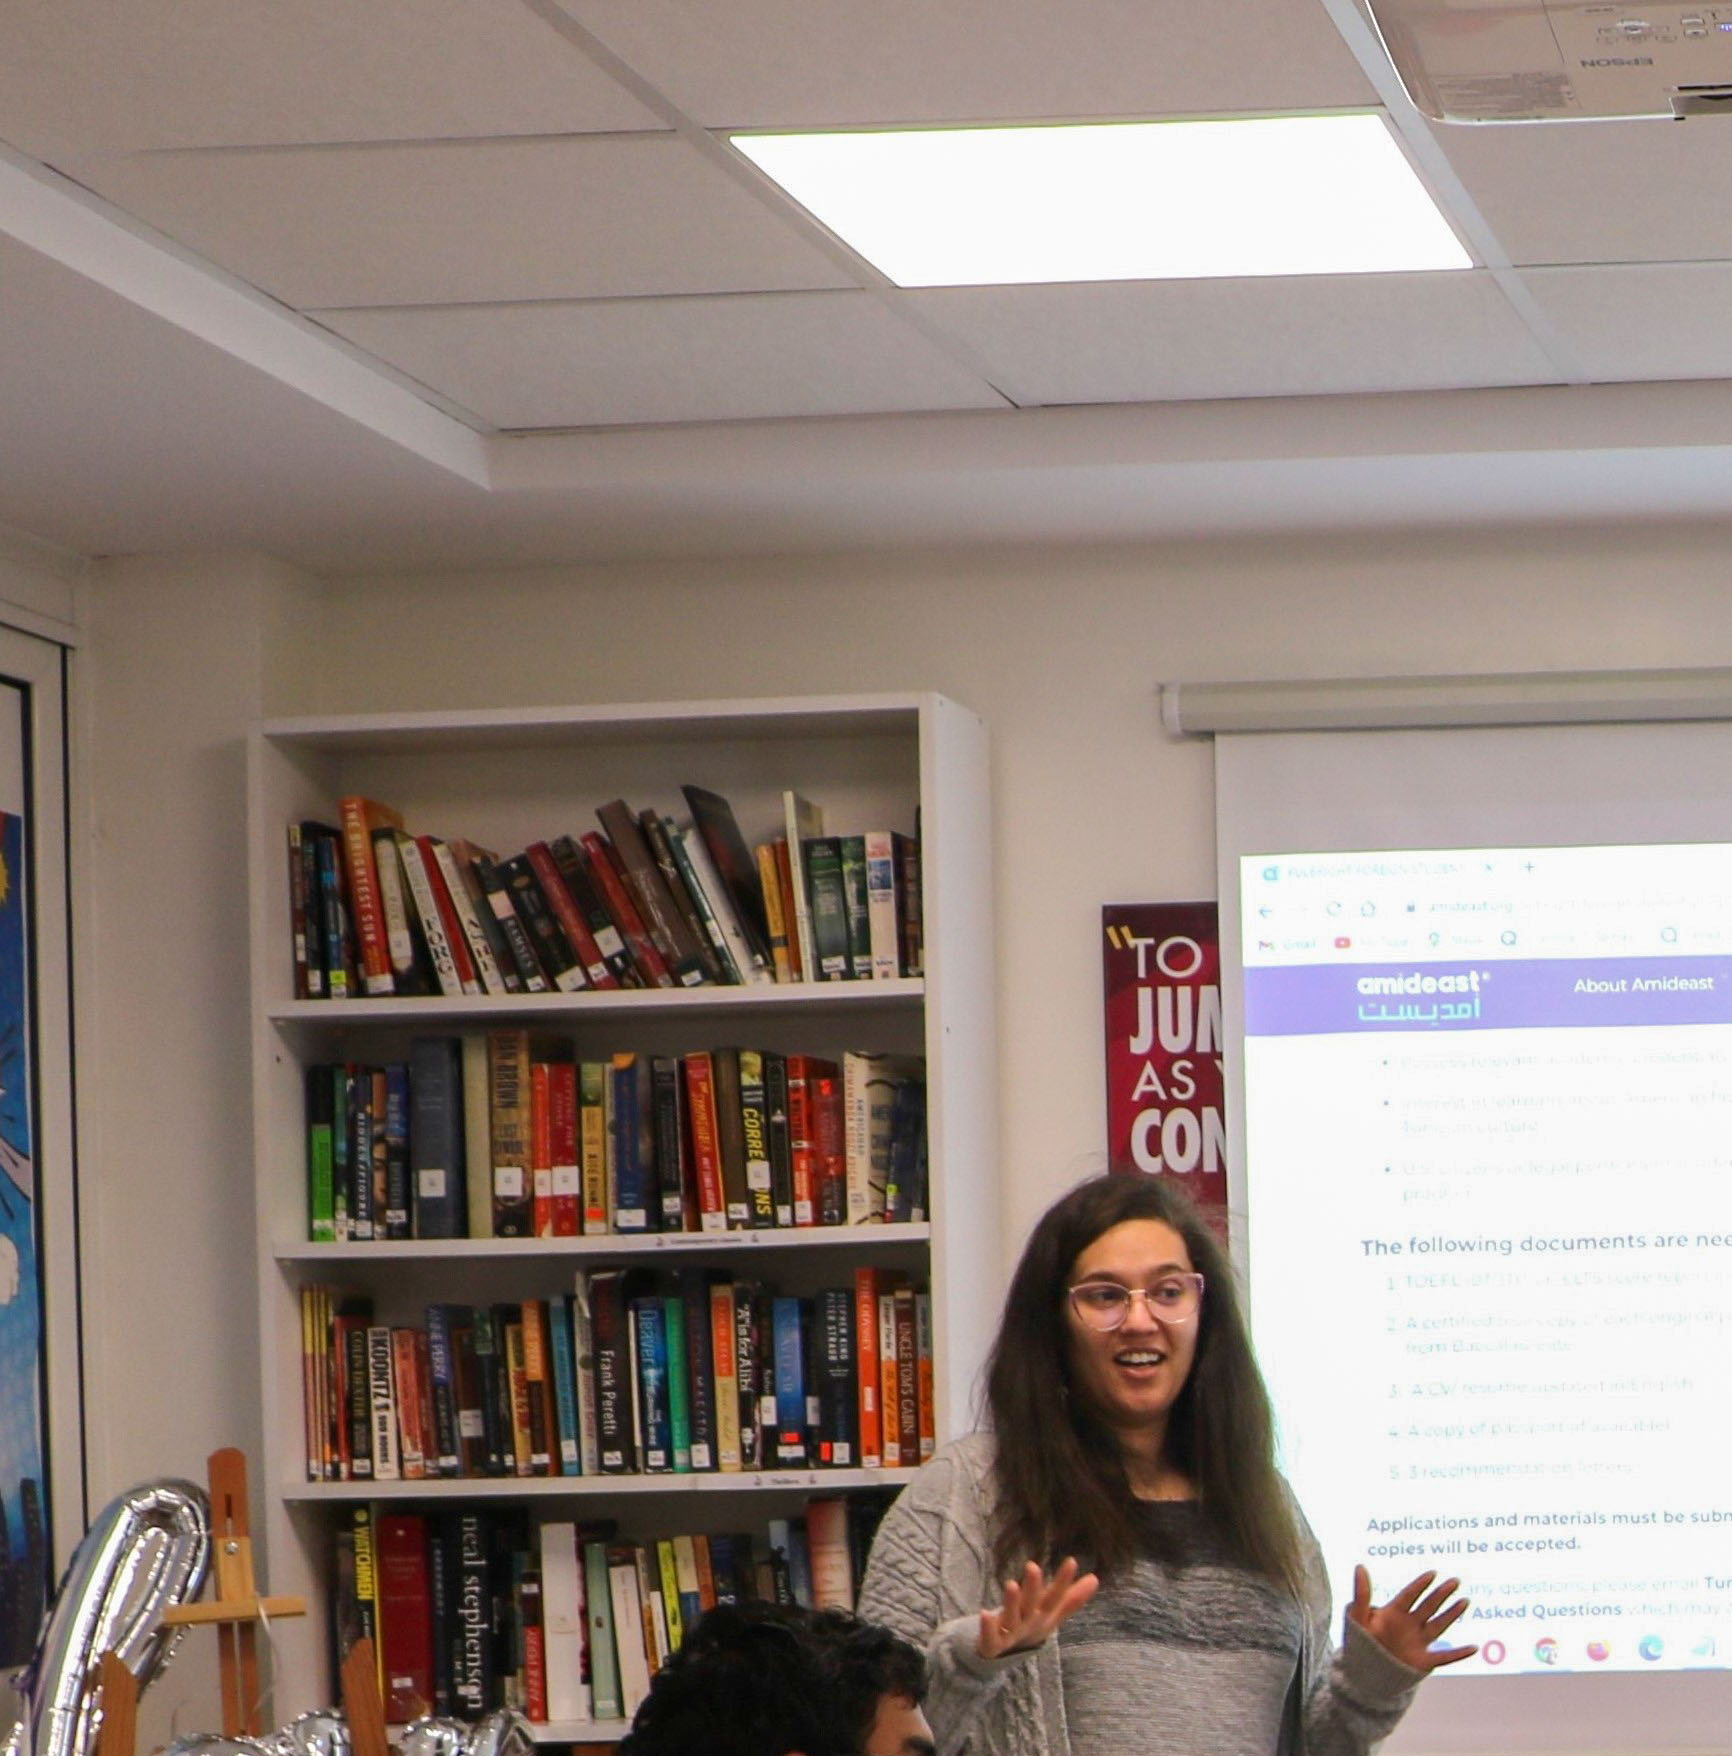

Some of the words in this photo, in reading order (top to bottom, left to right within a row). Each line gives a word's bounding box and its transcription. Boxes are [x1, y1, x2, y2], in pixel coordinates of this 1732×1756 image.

[1581, 57, 1654, 69] EPSON
[1357, 970, 1480, 996] amideast
[1575, 979, 1626, 992] About
[1632, 976, 1713, 990] Amideast
[1131, 1060, 1197, 1102] AS
[742, 1107, 772, 1216] CORREONS
[1362, 1240, 1402, 1256] The
[1410, 1237, 1512, 1255] following
[1520, 1235, 1646, 1251] documents
[1655, 1235, 1688, 1247] are
[839, 1337, 849, 1361] KING
[898, 1322, 913, 1361] UNCLE
[371, 1336, 391, 1401] KOONTZ
[432, 1343, 447, 1380] PERRY
[600, 1350, 615, 1387] Frank
[739, 1357, 753, 1392] Alibi
[899, 1362, 914, 1396] TOM'S
[602, 1391, 618, 1436] Peretti
[901, 1398, 915, 1434] CABIN
[1367, 1516, 1478, 1533] Applications
[1485, 1513, 1517, 1527] and
[1524, 1512, 1606, 1525] materials
[1613, 1512, 1656, 1524] must
[1664, 1511, 1684, 1523] be
[461, 1516, 488, 1566] neal
[1368, 1542, 1424, 1558] copies
[1431, 1541, 1460, 1553] will
[1467, 1540, 1488, 1553] be
[1495, 1537, 1580, 1552] accepted.
[353, 1527, 375, 1601] WATCHMEN
[1472, 1603, 1528, 1620] Asked
[1532, 1603, 1621, 1620] Questions
[457, 1575, 490, 1710] stephenson
